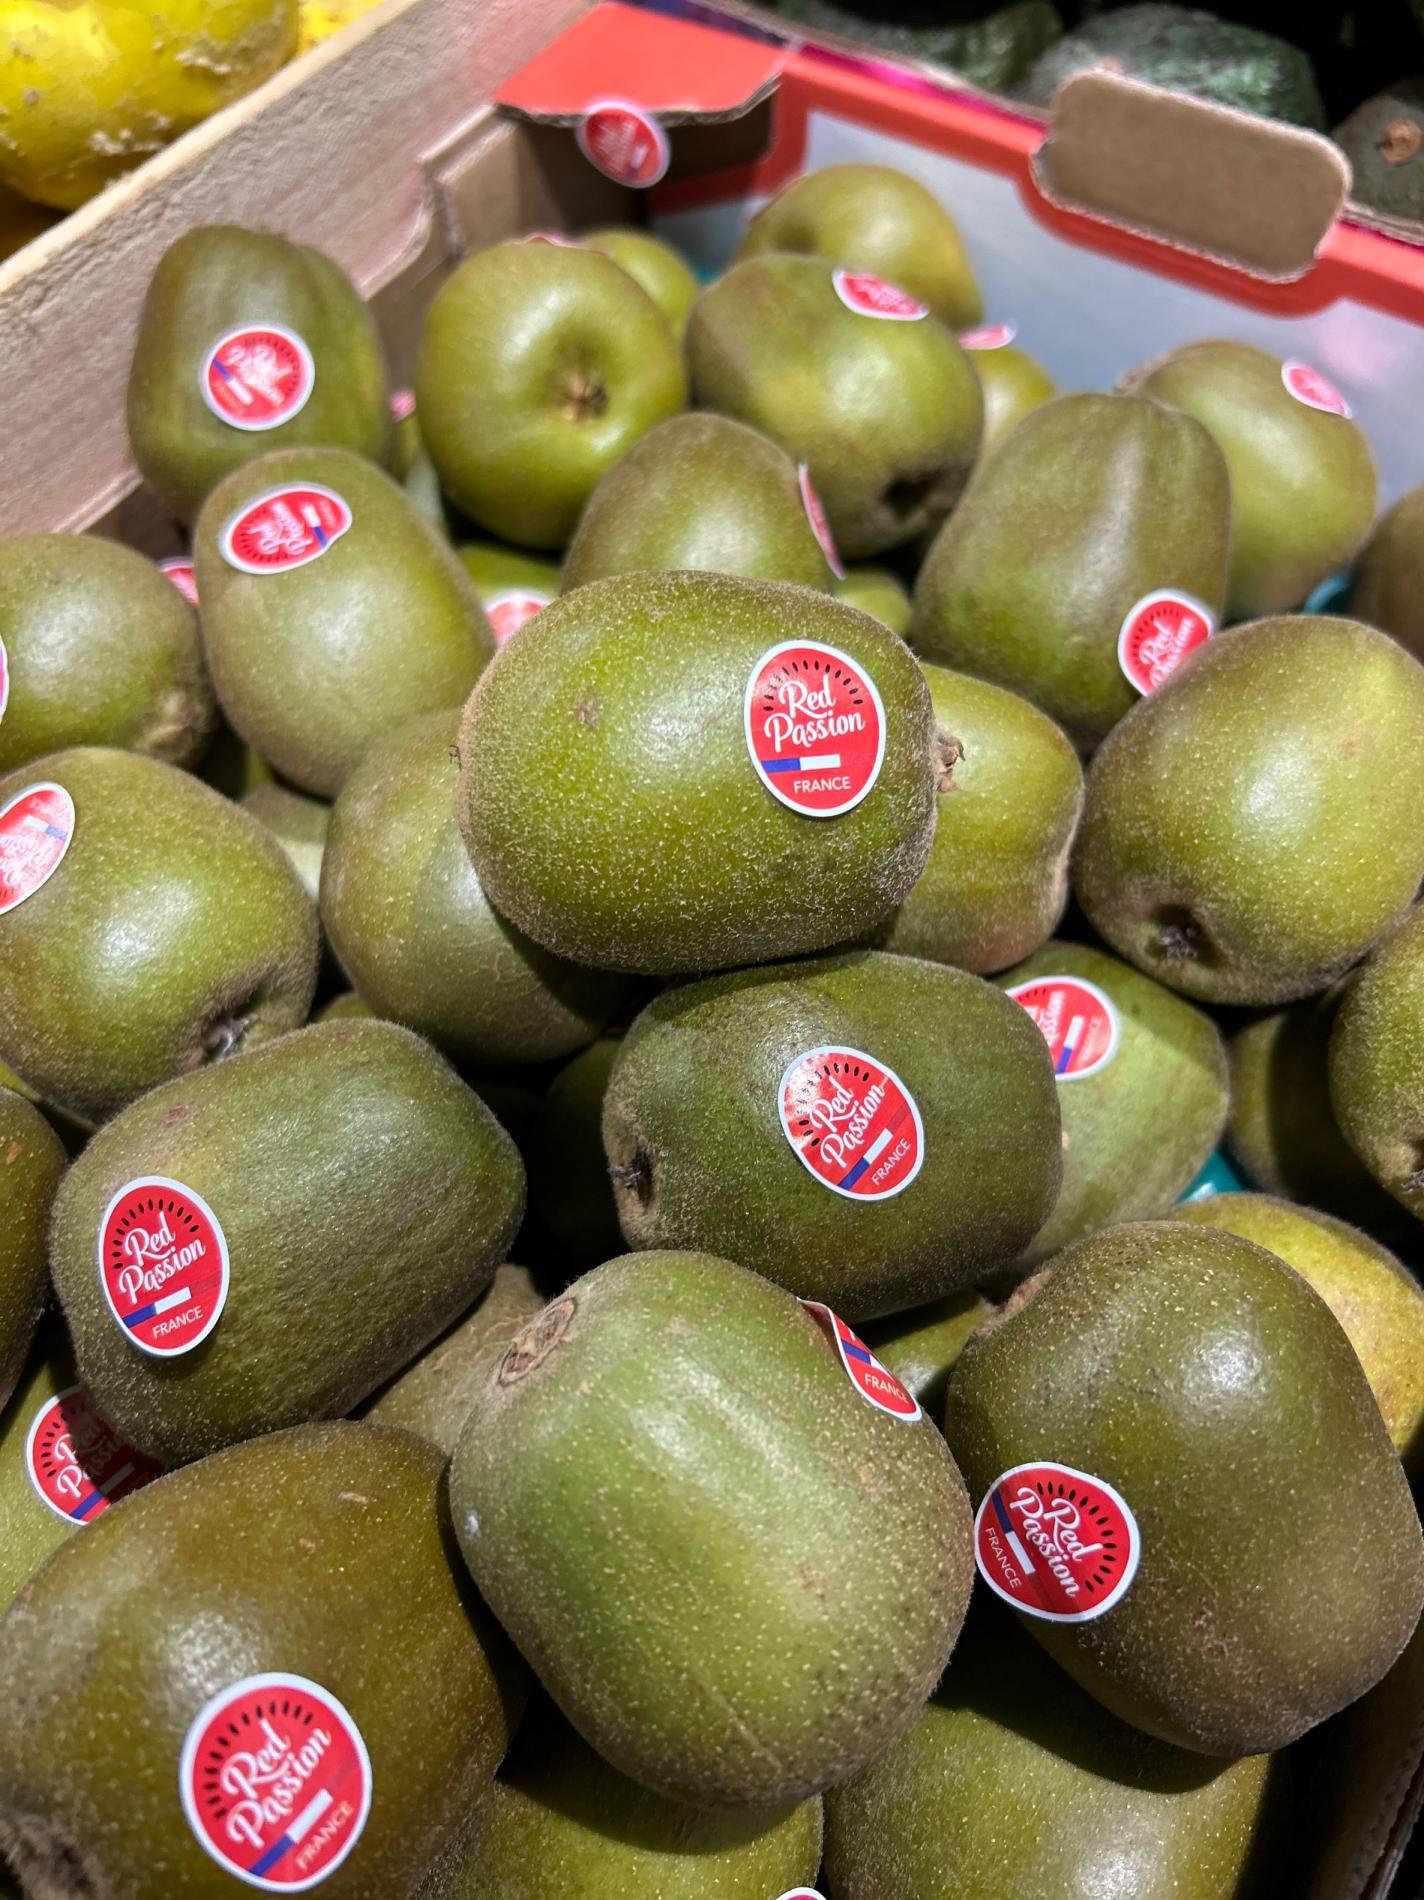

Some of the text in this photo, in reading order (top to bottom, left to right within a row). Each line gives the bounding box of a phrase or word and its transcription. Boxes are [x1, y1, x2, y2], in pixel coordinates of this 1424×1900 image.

[778, 674, 836, 719] Red
[764, 711, 866, 753] Passion
[793, 776, 852, 794] FRANCE
[810, 1077, 855, 1130] Red
[820, 1078, 887, 1168] Passion
[872, 1138, 911, 1185] FRANCE
[124, 1211, 177, 1267] Red
[119, 1238, 207, 1304] Passion
[152, 1309, 203, 1339] FRANCE
[985, 1527, 1021, 1588] FRANCE
[1009, 1487, 1080, 1598] Passion
[1043, 1497, 1101, 1564] Red
[222, 1720, 291, 1799] Red
[227, 1728, 332, 1847] Passion
[295, 1800, 353, 1869] FRANCE
